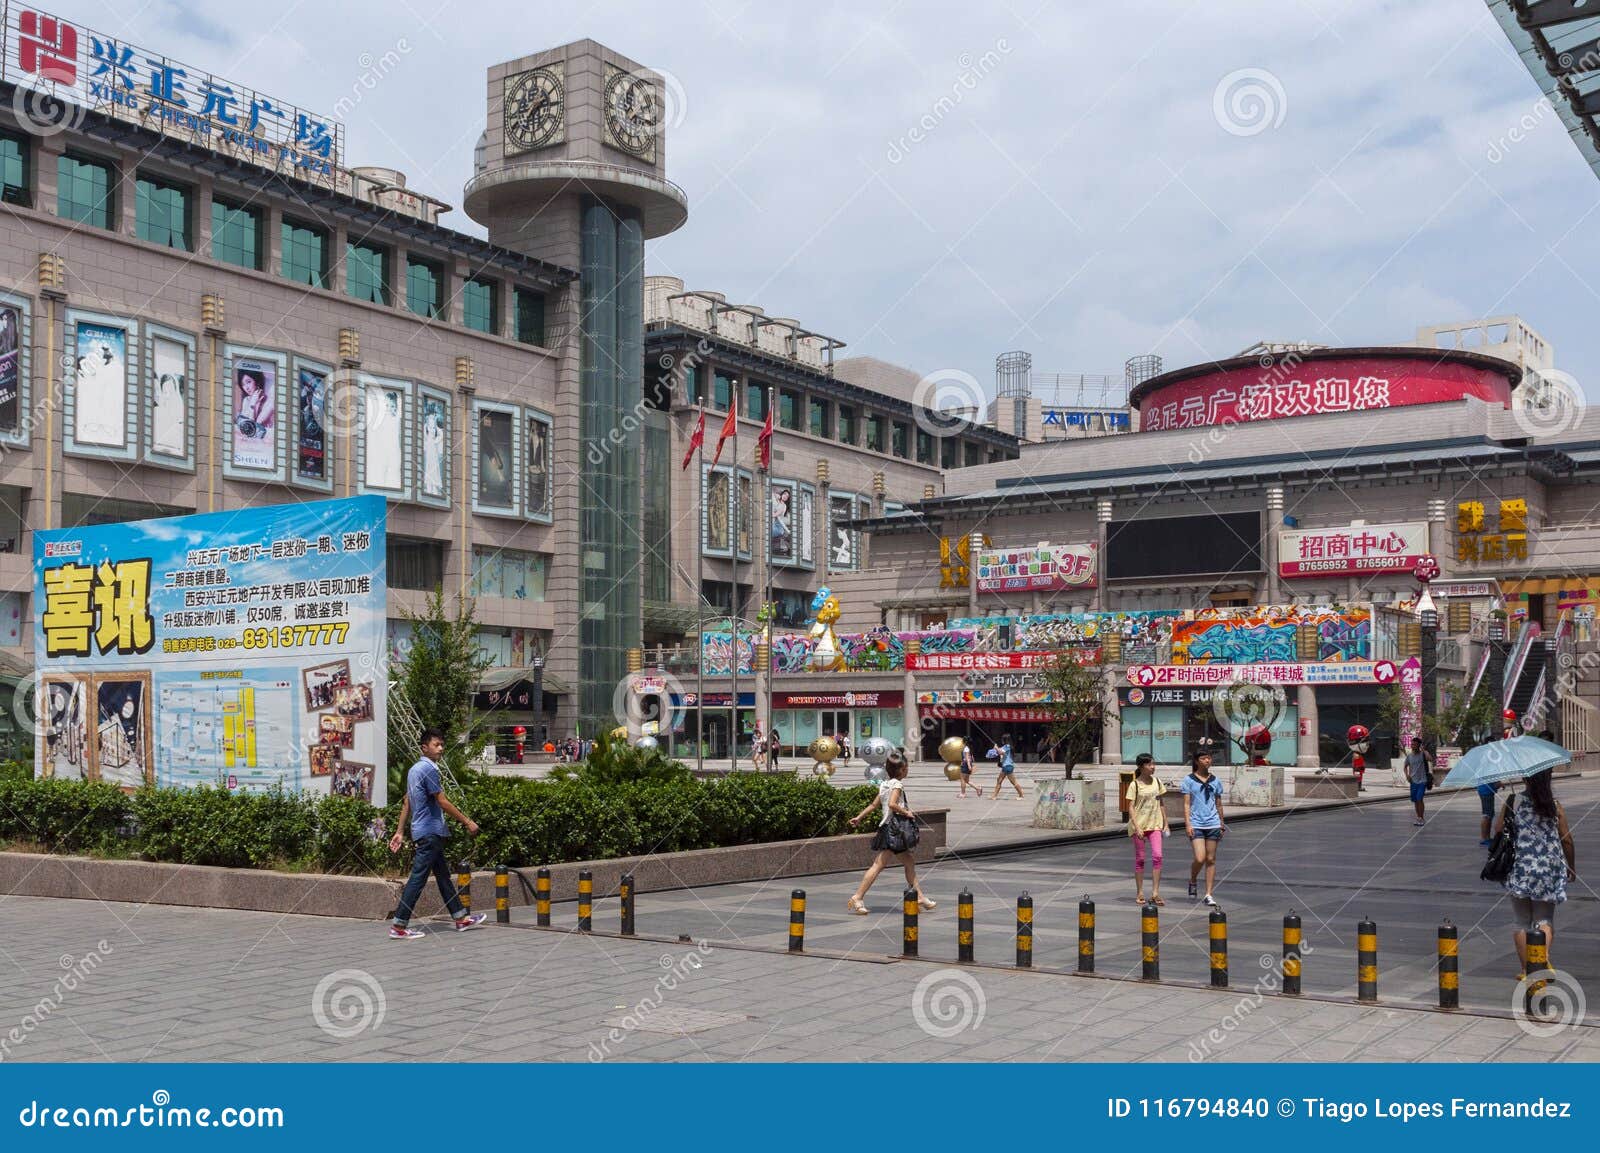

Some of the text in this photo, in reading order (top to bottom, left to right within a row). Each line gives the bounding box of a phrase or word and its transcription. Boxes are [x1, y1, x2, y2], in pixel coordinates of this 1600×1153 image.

[90, 35, 333, 158] 兴正元广场
[90, 81, 138, 110] XING
[150, 103, 212, 135] ZHENG
[222, 129, 269, 155] YUAN
[1146, 376, 1390, 431] 兴正元广场欢迎您
[187, 532, 370, 567] 兴正元广场地下一层迷你一期、迷你
[1299, 531, 1408, 558] 招商中心
[1059, 553, 1091, 577] 3F
[1299, 557, 1407, 571] 87656952 87656017
[185, 577, 370, 607] 西安兴正元地产开发有限公司现加推
[43, 557, 155, 658] 喜讯
[1157, 668, 1176, 683] 2F
[1177, 667, 1233, 683] 时尚包城
[1241, 665, 1303, 682] 时尚鞋城
[1402, 668, 1421, 682] 2F
[1151, 690, 1184, 702] 汉堡王
